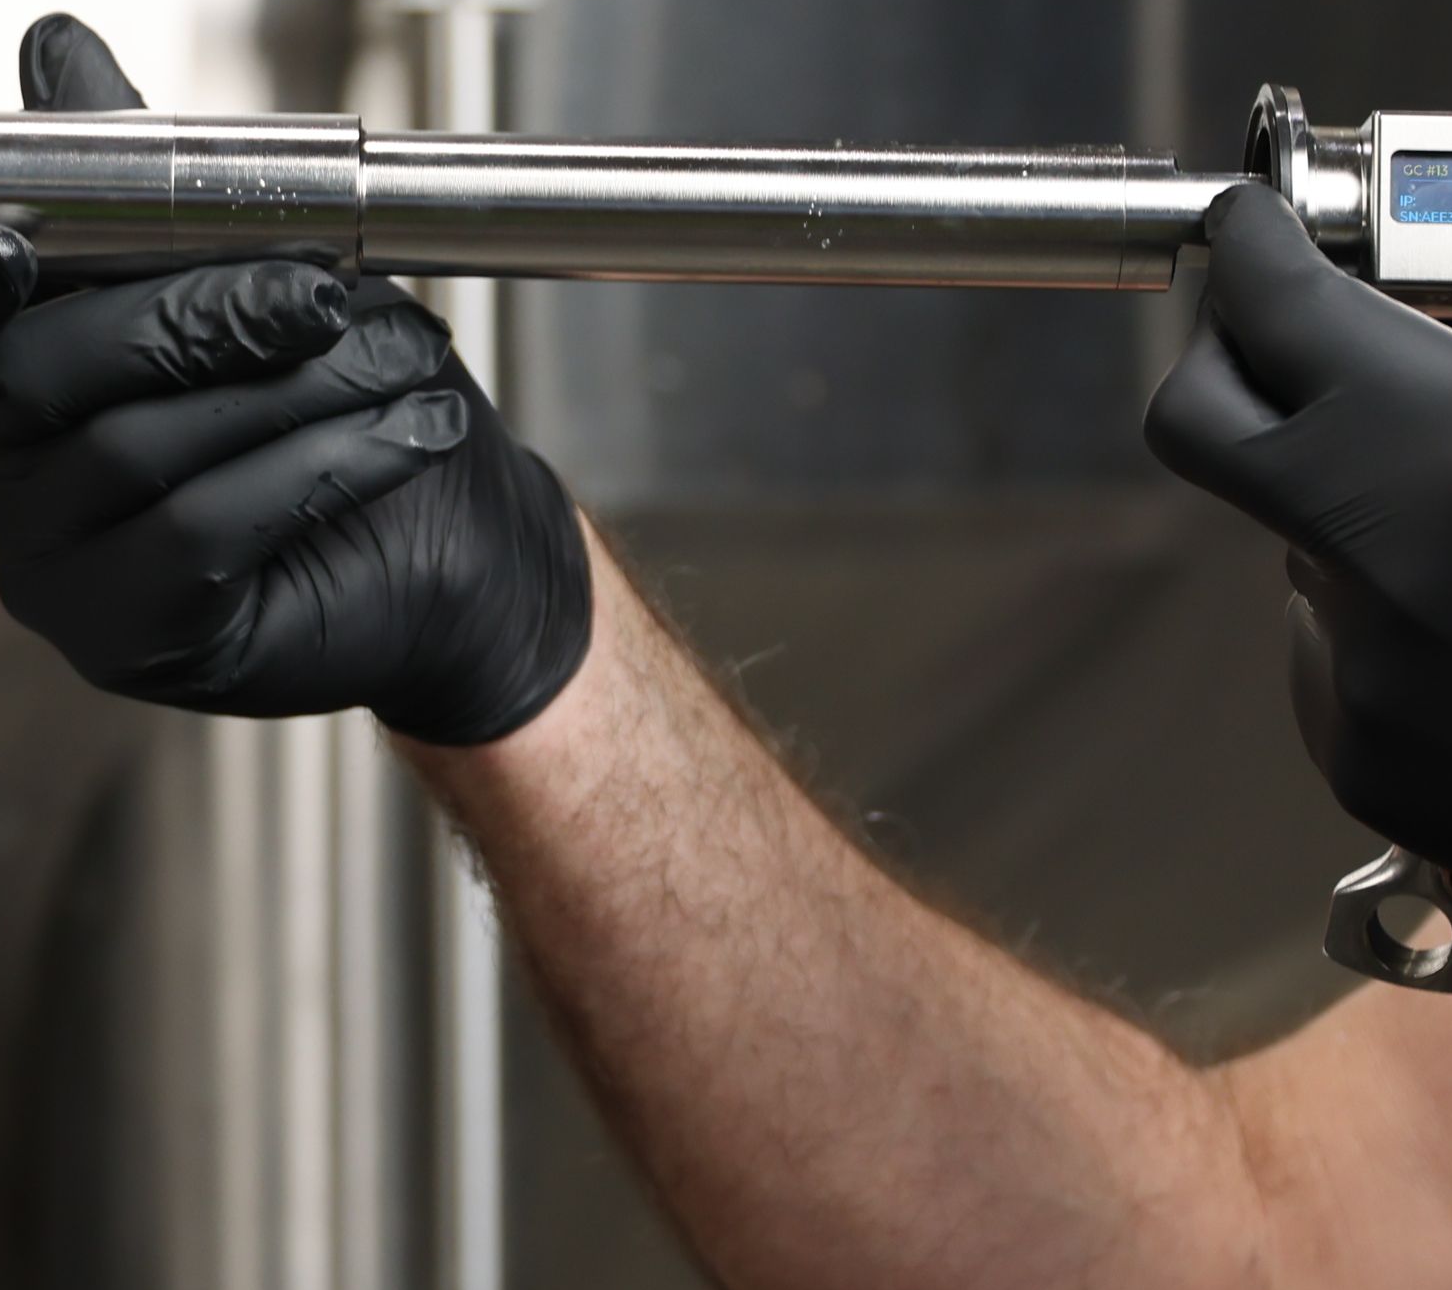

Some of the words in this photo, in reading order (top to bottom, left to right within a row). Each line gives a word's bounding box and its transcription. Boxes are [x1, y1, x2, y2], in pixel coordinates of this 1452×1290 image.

[1403, 164, 1422, 176] GC
[1426, 164, 1448, 177] #13
[1399, 194, 1416, 207] IP:
